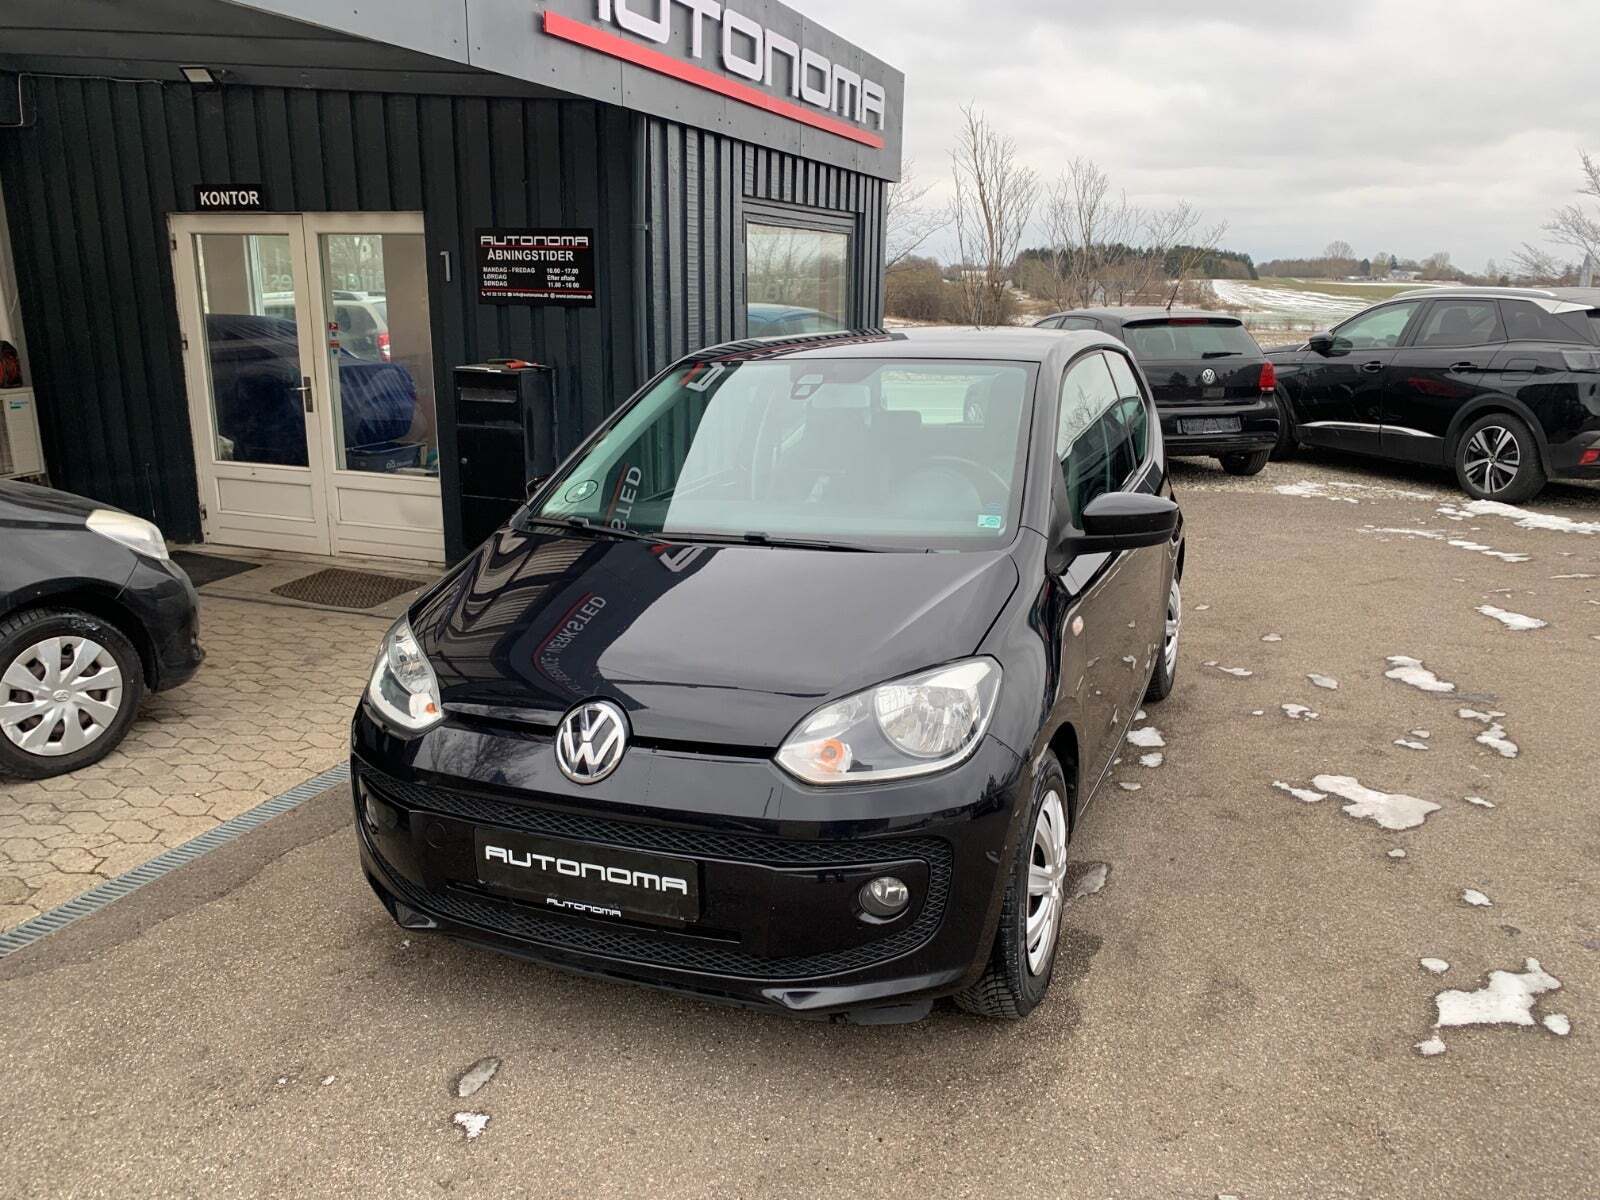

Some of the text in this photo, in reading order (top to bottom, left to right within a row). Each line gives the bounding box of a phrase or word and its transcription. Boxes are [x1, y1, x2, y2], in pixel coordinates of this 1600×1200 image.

[597, 0, 885, 131] UTONOMA
[199, 190, 260, 206] KONTOR
[480, 235, 589, 246] AUTONOMA
[487, 248, 574, 262] ÅBNINGSTIDER
[484, 844, 688, 896] AUTONOMA
[546, 897, 622, 918] AUTONOMA
